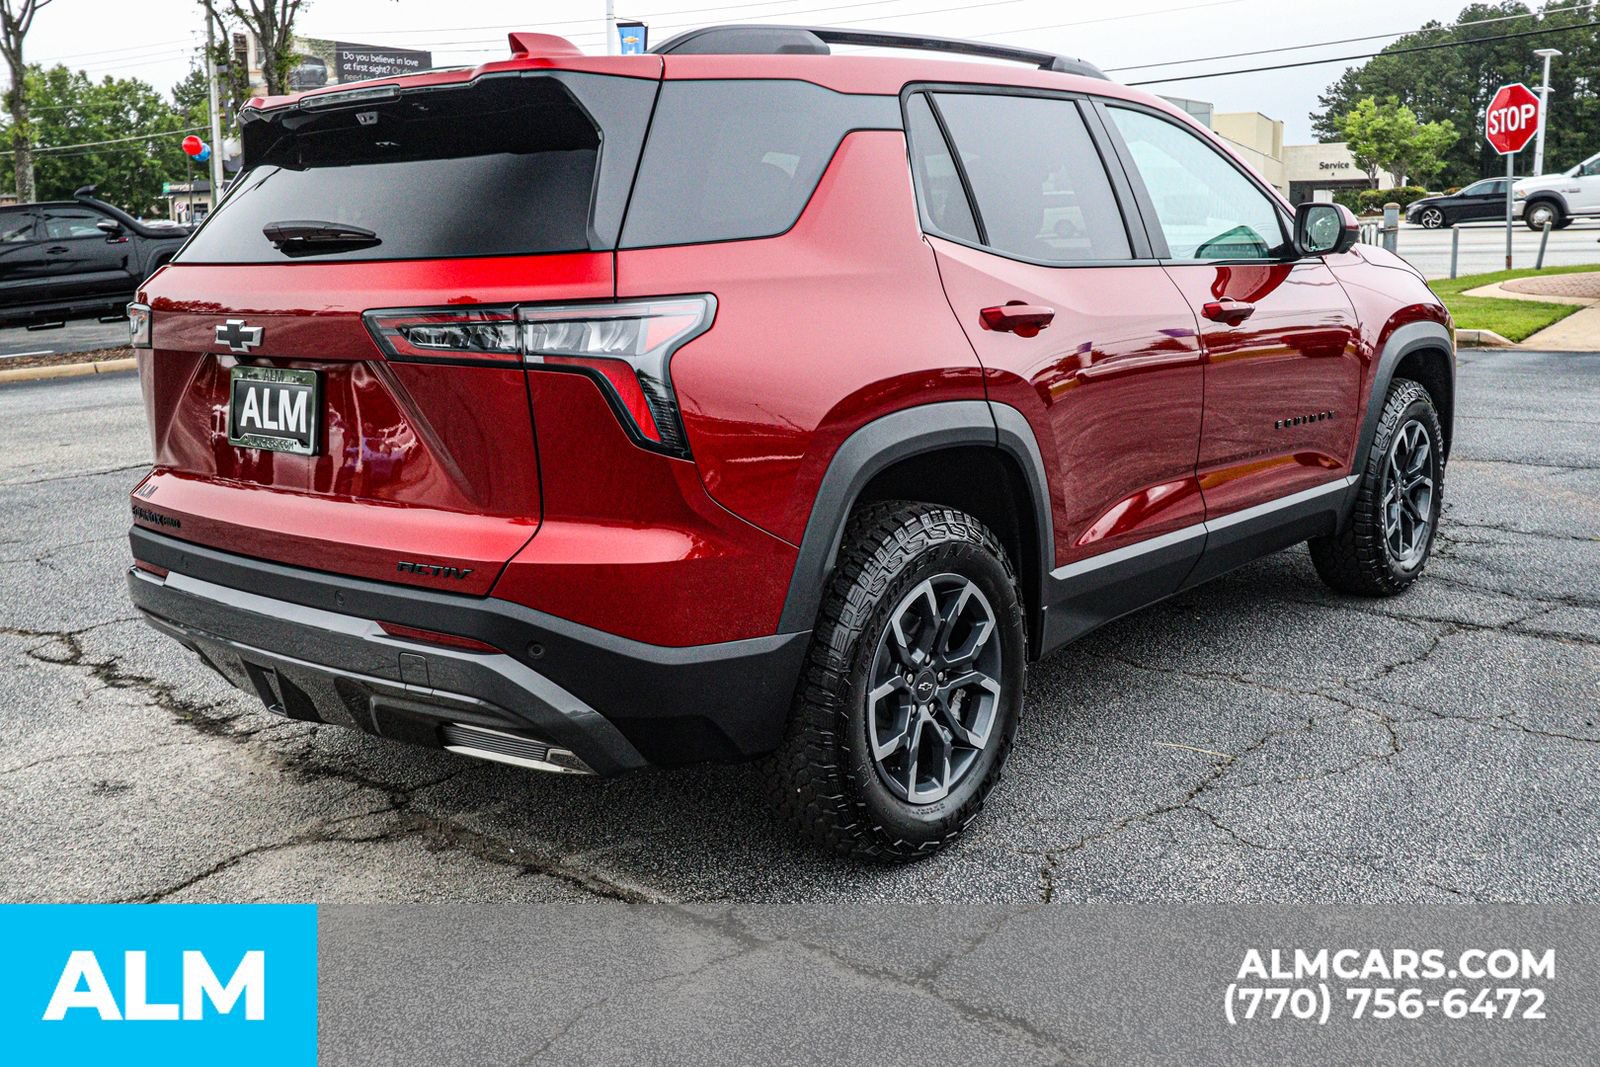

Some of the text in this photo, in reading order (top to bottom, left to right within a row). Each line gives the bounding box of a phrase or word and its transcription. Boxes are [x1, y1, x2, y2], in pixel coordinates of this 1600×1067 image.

[342, 51, 419, 67] Do you believe in love
[343, 63, 351, 71] at
[352, 62, 368, 72] first
[369, 65, 390, 75] sight?
[391, 66, 401, 74] Or
[1488, 103, 1537, 135] STOP
[1319, 161, 1350, 170] Service
[240, 386, 308, 434] ALM
[396, 561, 474, 580] ACTIV
